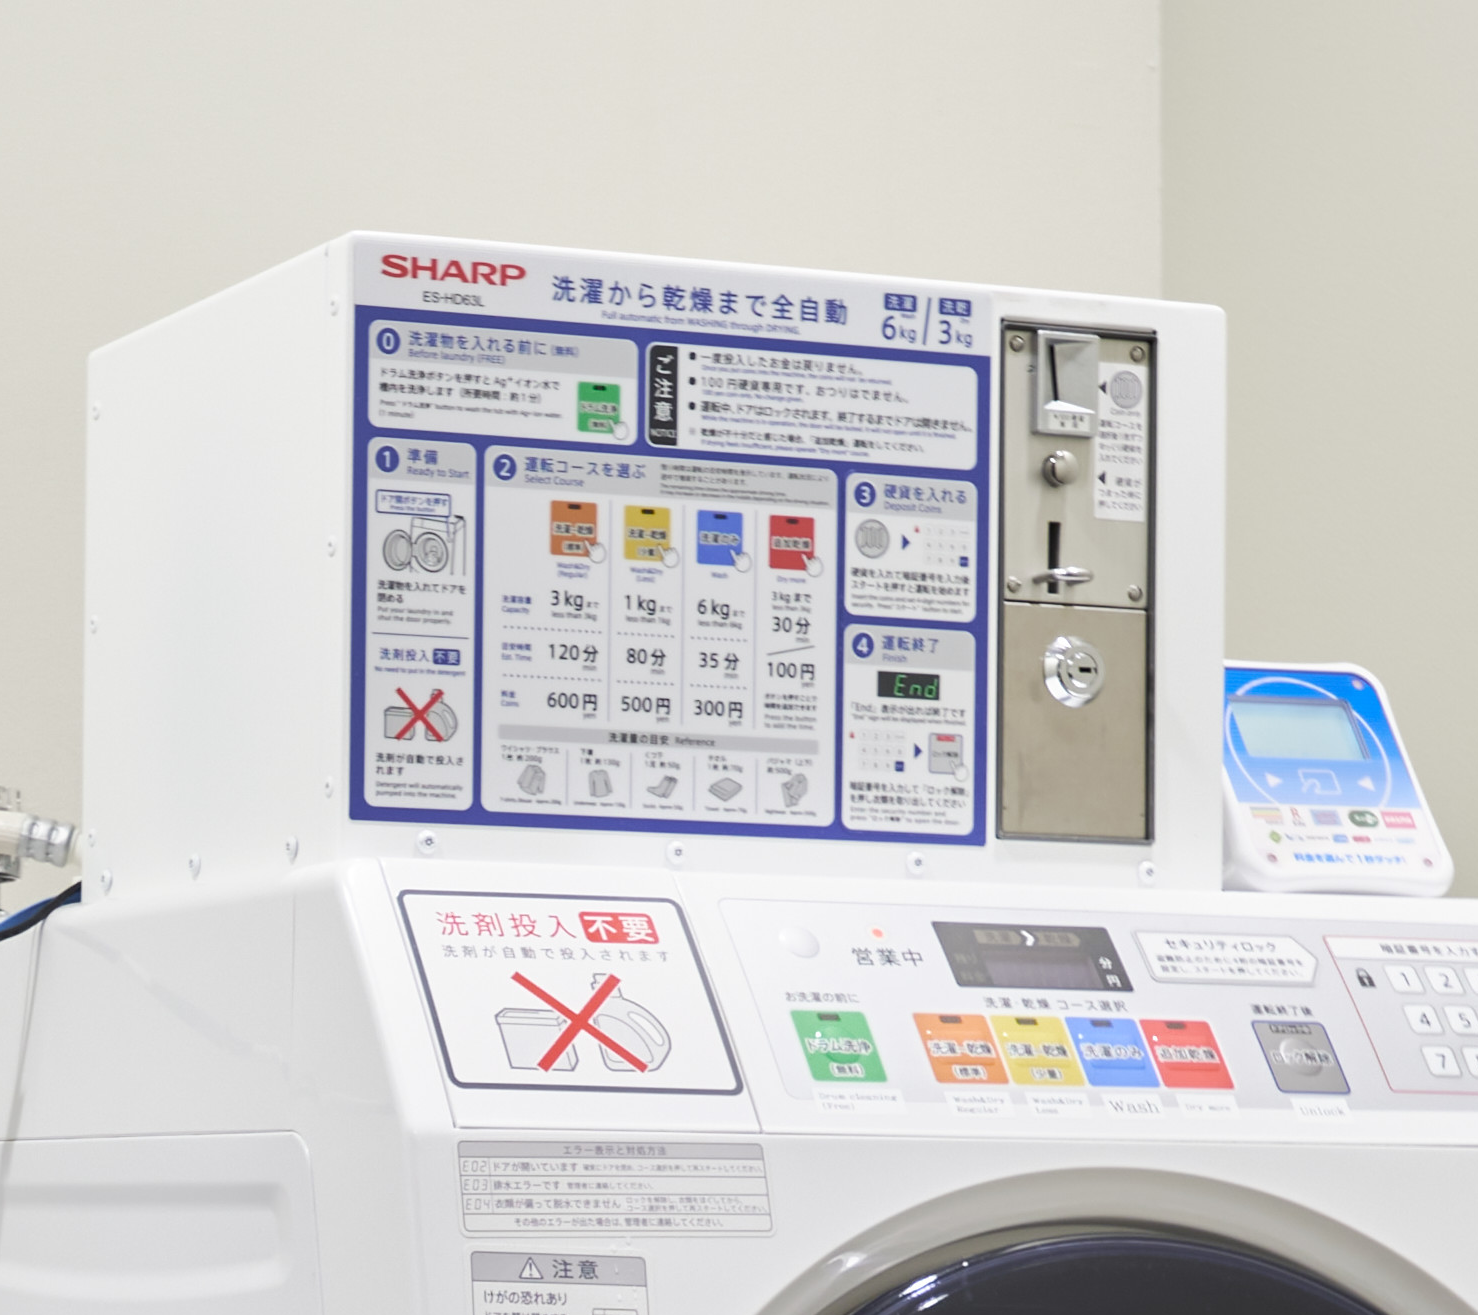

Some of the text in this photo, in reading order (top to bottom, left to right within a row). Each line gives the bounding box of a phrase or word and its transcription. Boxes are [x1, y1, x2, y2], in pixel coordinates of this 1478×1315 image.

[381, 254, 526, 286] SHARP
[422, 291, 485, 307] ES-HD63L
[552, 275, 847, 326] 洗濯から乾燥まで全自動
[894, 674, 938, 698] End
[436, 911, 654, 942] 洗剤投入 不要
[442, 945, 669, 962] 洗剤が自動で投入されます
[851, 948, 923, 967] 営業中
[552, 1259, 598, 1280] 注意
[484, 1291, 567, 1305] けがの恐れあり
